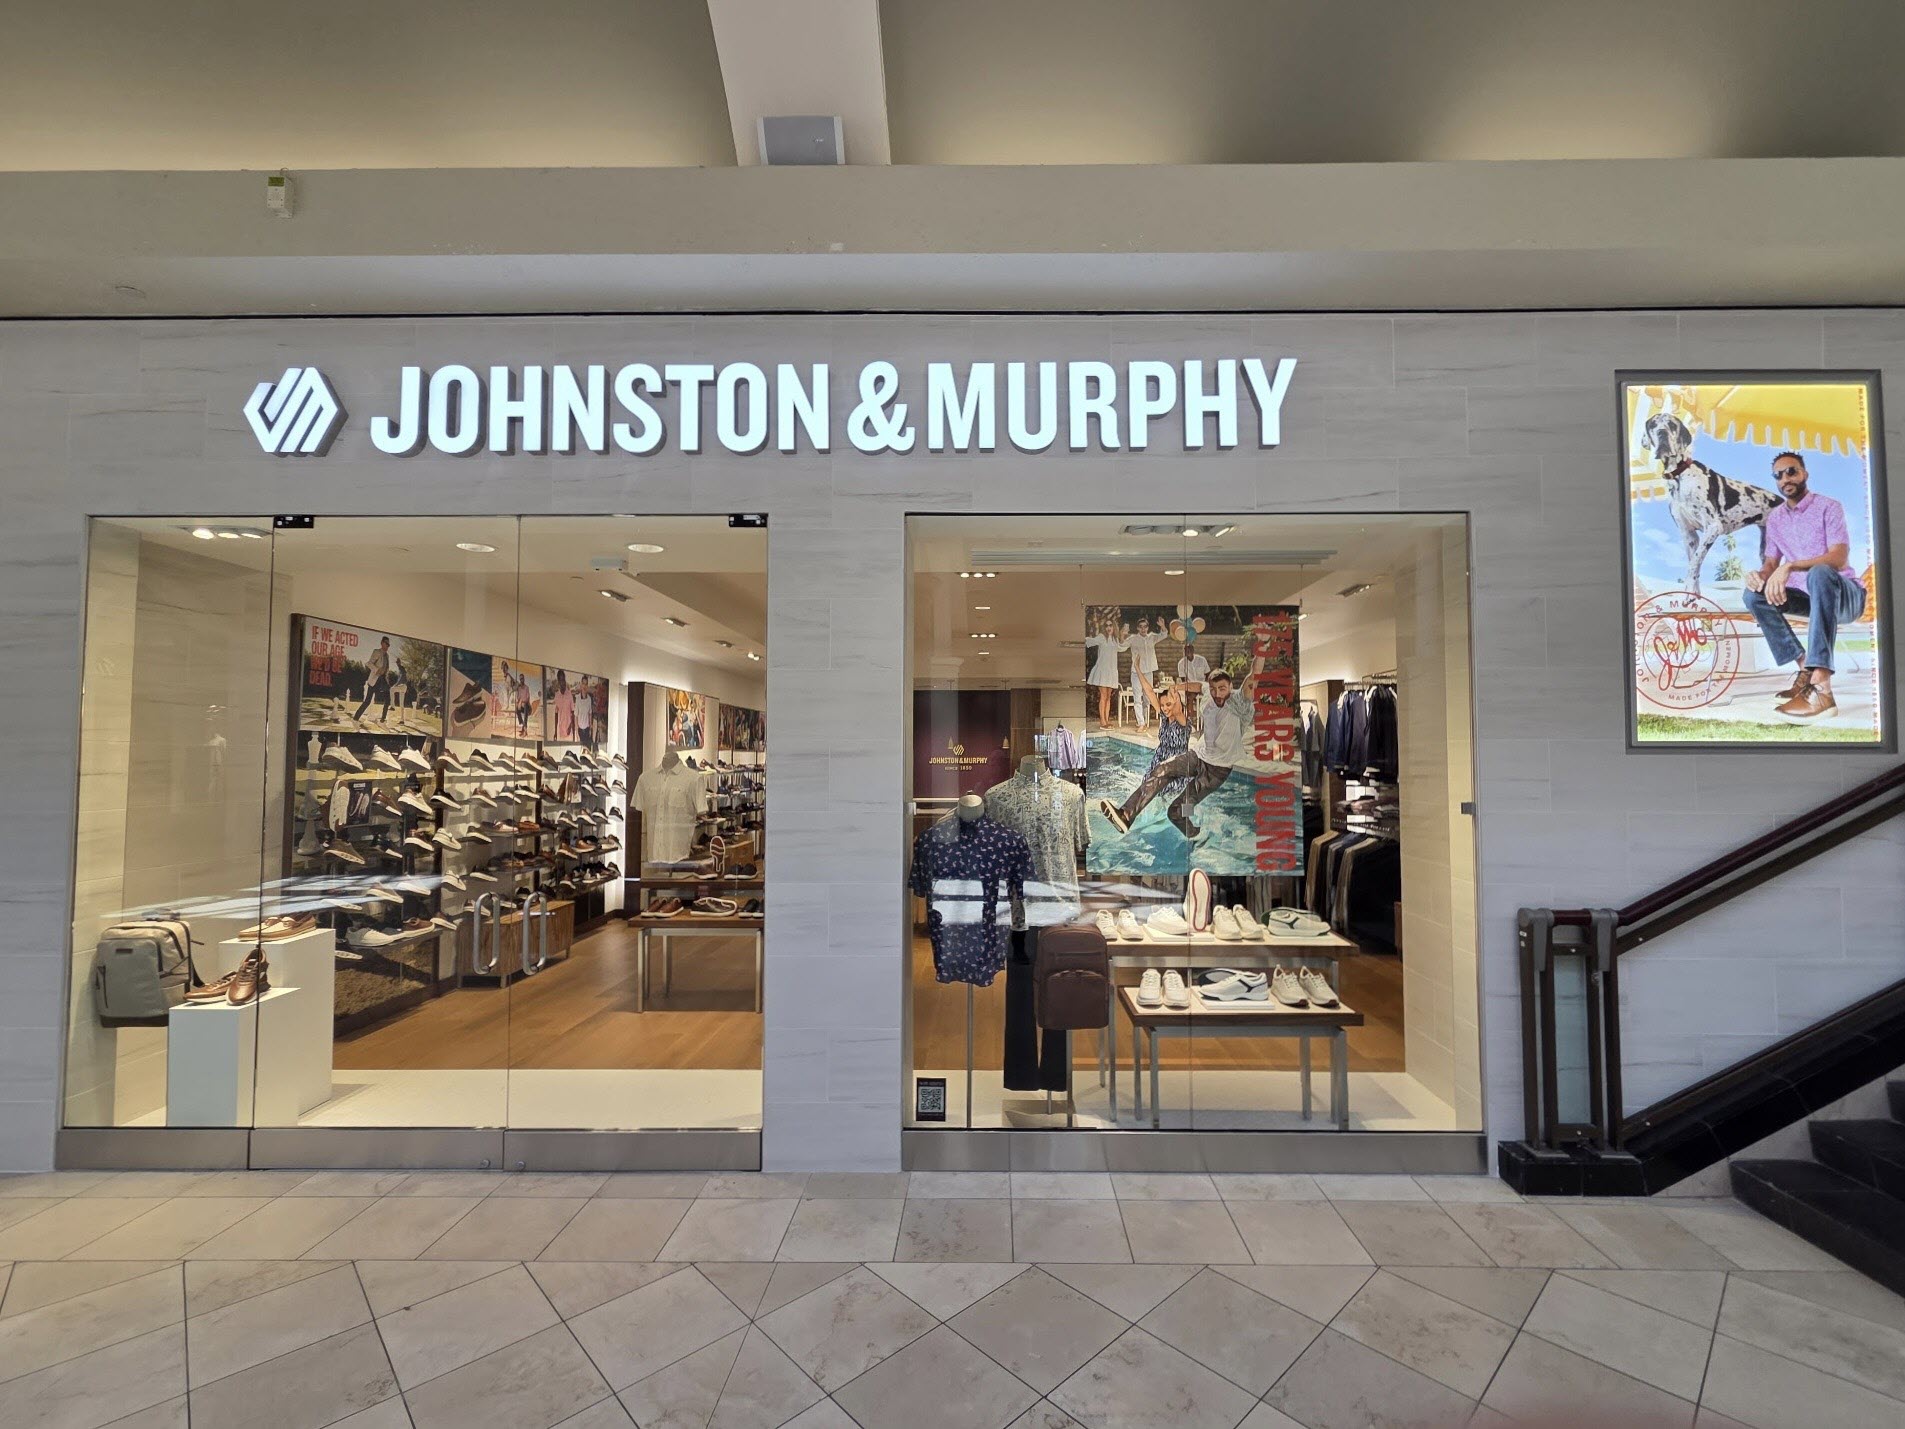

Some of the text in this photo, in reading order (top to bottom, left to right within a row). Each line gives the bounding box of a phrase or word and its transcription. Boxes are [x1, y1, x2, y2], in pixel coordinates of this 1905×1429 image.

[371, 363, 829, 454] JOHNSTON
[848, 360, 916, 451] &
[928, 358, 1298, 450] MURPHY
[312, 626, 358, 647] IF WE ACTED
[312, 641, 328, 656] OUR
[1254, 669, 1295, 763] YEARS
[1668, 694, 1693, 702] MADE
[1254, 771, 1298, 873] YOUNG
